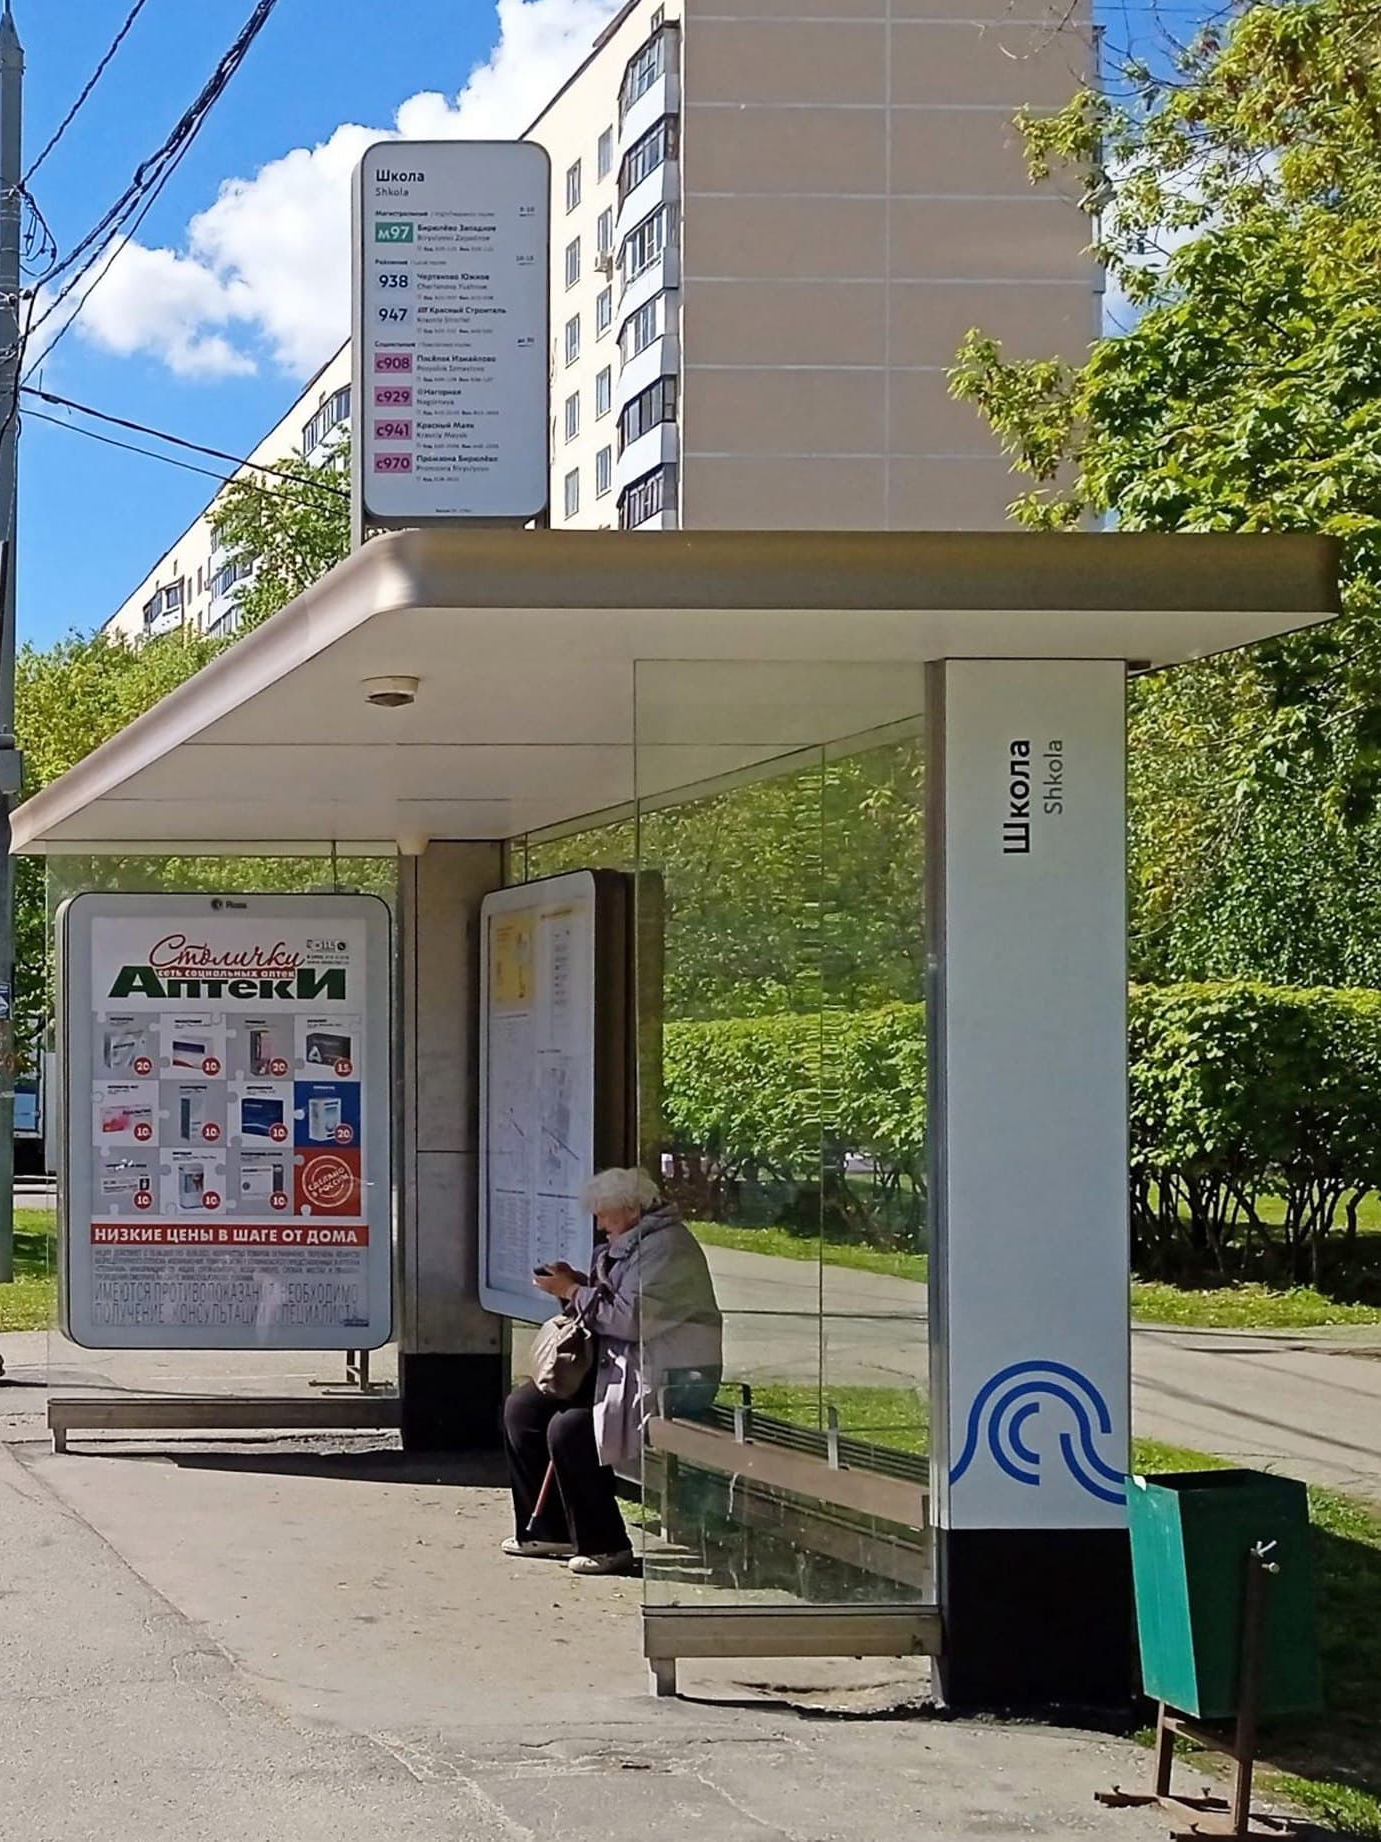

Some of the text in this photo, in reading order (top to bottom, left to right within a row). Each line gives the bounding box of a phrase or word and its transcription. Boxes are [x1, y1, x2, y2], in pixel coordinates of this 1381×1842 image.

[375, 169, 425, 182] Школа
[375, 187, 409, 197] Shkola
[379, 274, 409, 288] 938
[379, 308, 408, 321] 947
[376, 357, 410, 369] с908
[376, 390, 410, 403] с929
[376, 423, 410, 437] с941
[376, 457, 410, 470] с970
[1043, 740, 1063, 815] Shkola
[1003, 740, 1030, 854] Школа
[149, 934, 305, 967] Столички
[158, 969, 295, 978] сеть социальных аптек
[95, 1228, 358, 1244] НИЗКИЕ ЦЕНЫ В ШАГЕ ОТ ДОМА
[95, 1283, 151, 1302] ИМЕЮТСЯ
[95, 1303, 163, 1323] ПОЛУЧЕНИЕ
